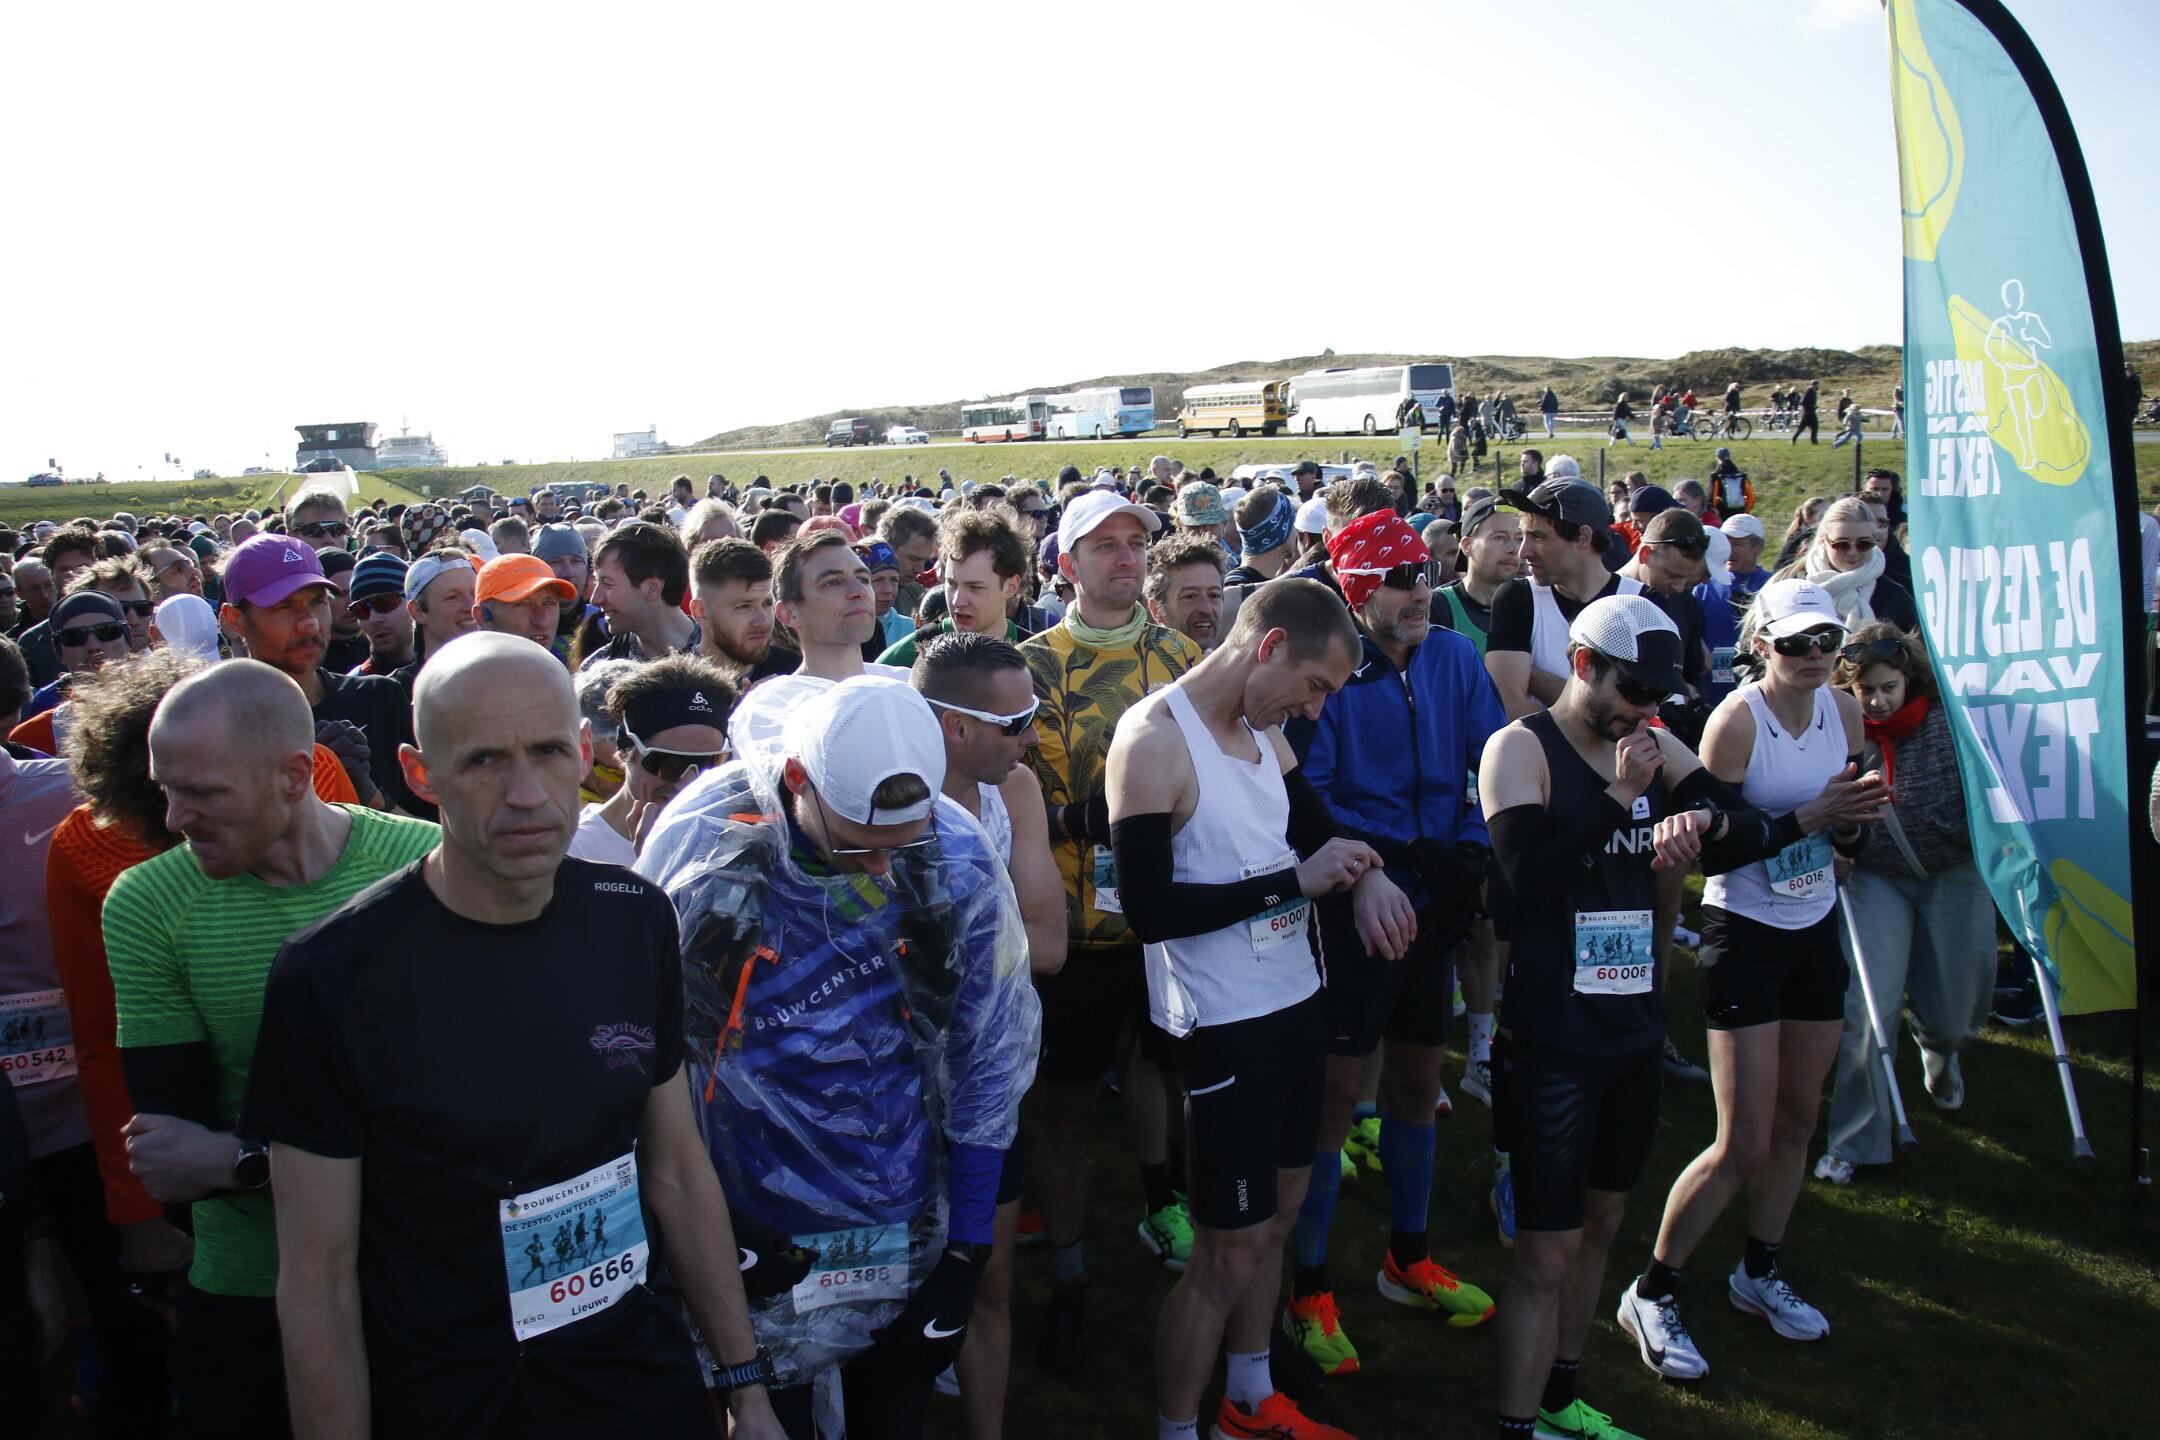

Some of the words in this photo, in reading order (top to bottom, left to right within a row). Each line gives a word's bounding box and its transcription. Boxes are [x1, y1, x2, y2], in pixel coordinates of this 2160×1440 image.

[594, 882, 644, 895] ROGELLI
[524, 1181, 591, 1210] BOUWCENTER
[594, 1170, 613, 1185] RAB
[505, 1224, 519, 1233] DE
[521, 1214, 552, 1230] ZESTIG
[554, 1207, 572, 1219] VAN
[574, 1198, 598, 1211] TEXEL
[600, 1188, 617, 1201] 2026
[571, 1295, 610, 1316] Lieuwe
[516, 1314, 545, 1326] TESO
